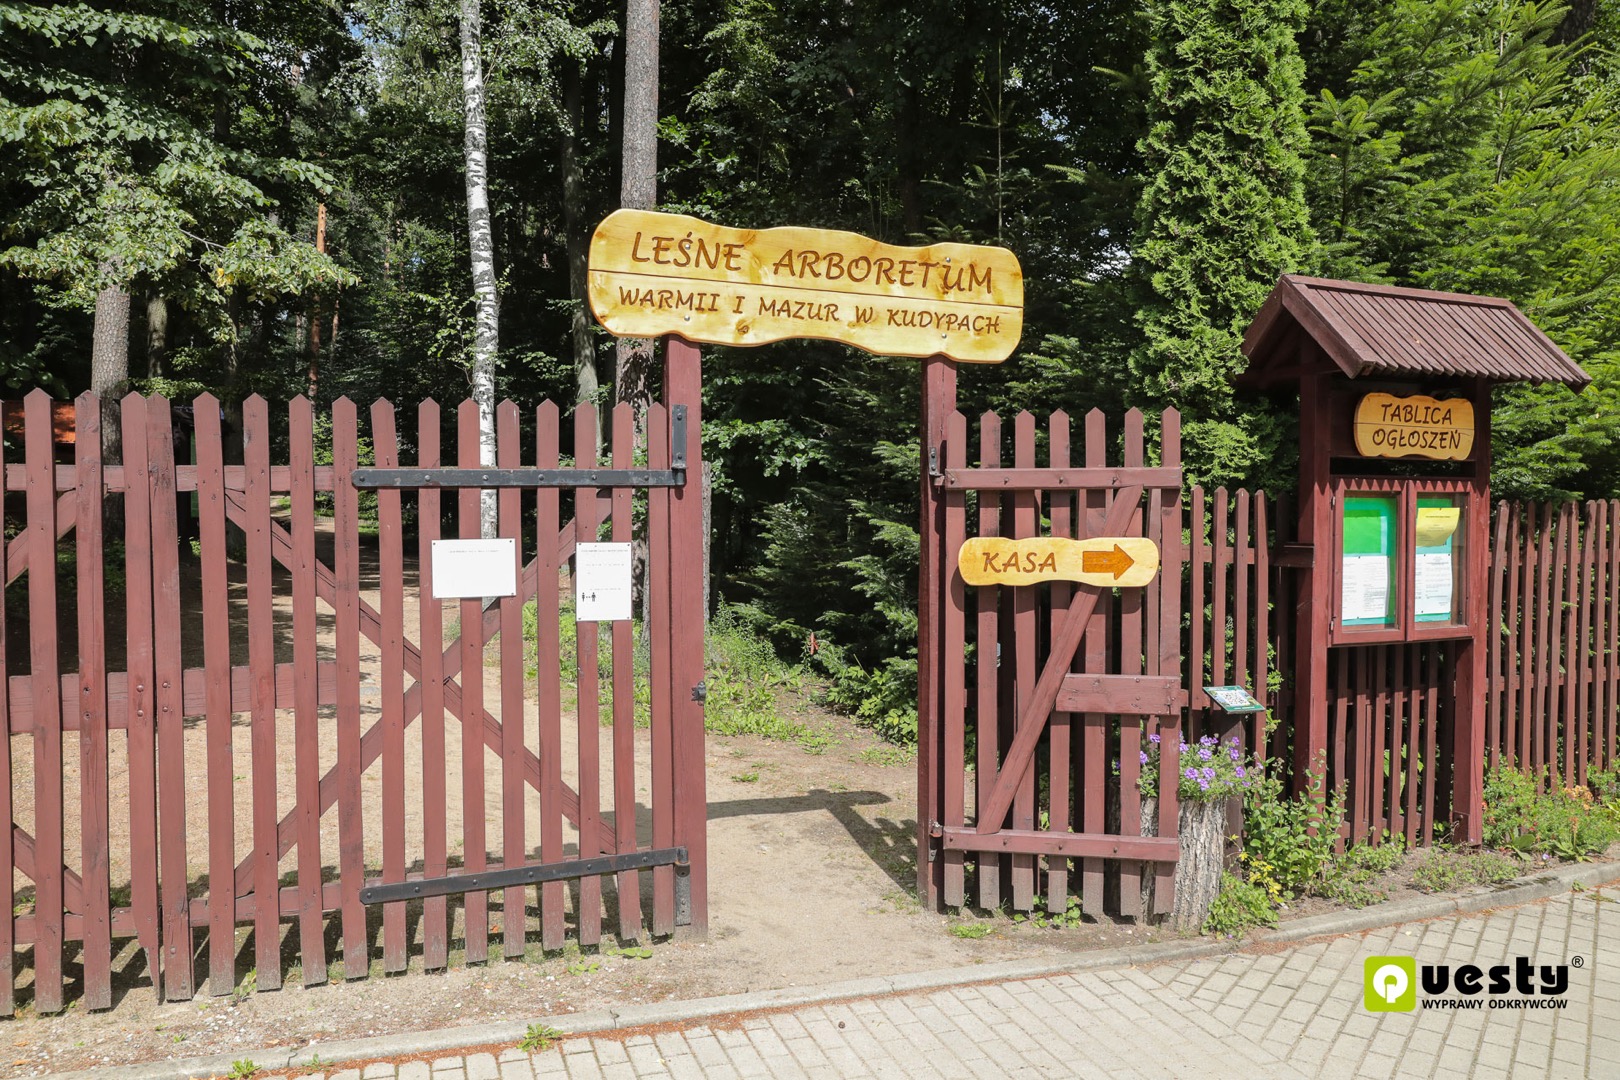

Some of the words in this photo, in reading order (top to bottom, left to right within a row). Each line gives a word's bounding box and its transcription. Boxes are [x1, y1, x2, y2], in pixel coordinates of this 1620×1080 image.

[631, 231, 744, 272] LEŚNE
[773, 249, 994, 294] ARBORETUM
[618, 286, 720, 312] WARMII
[732, 295, 744, 314] I
[758, 297, 840, 322] MAZUR
[855, 306, 874, 325] W
[887, 309, 1001, 335] KUDYPACH
[1381, 403, 1452, 425] TABLICA
[1372, 428, 1461, 450] OGŁOSZEŃ
[982, 552, 1057, 573] KASA
